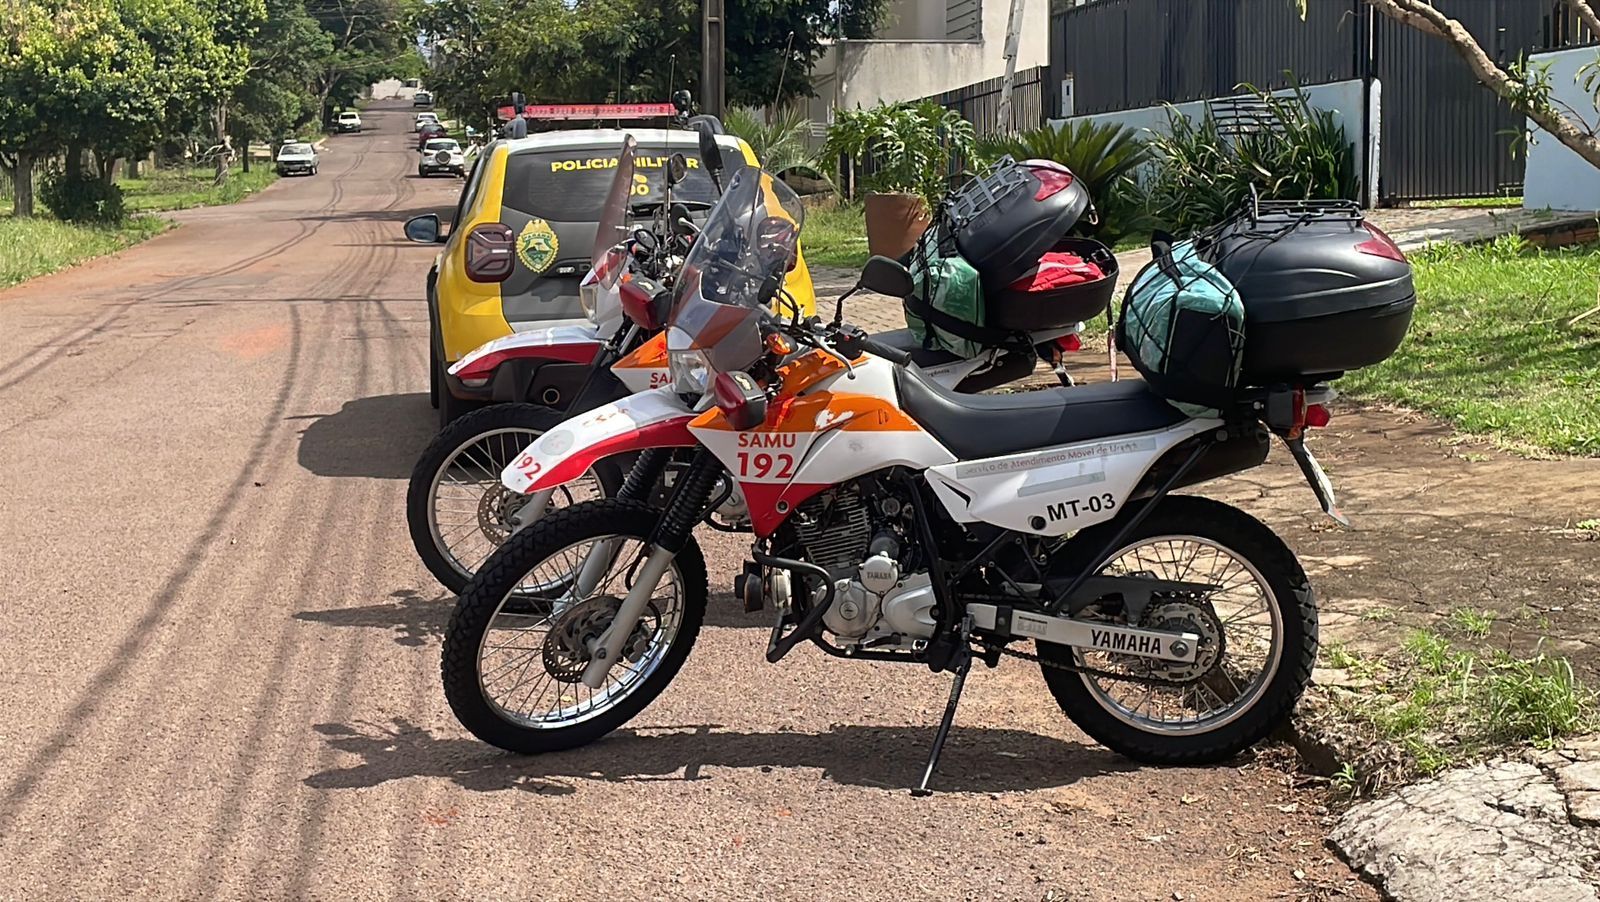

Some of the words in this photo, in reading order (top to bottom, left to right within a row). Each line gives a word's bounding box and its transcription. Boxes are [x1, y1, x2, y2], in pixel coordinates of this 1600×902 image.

[551, 158, 618, 172] POLÍCIA
[738, 433, 797, 448] SAMU
[513, 452, 542, 481] 192
[737, 452, 794, 478] 192
[1010, 455, 1066, 469] Atendimento
[1046, 492, 1116, 522] MT-03
[1090, 629, 1162, 655] YAMAHA
